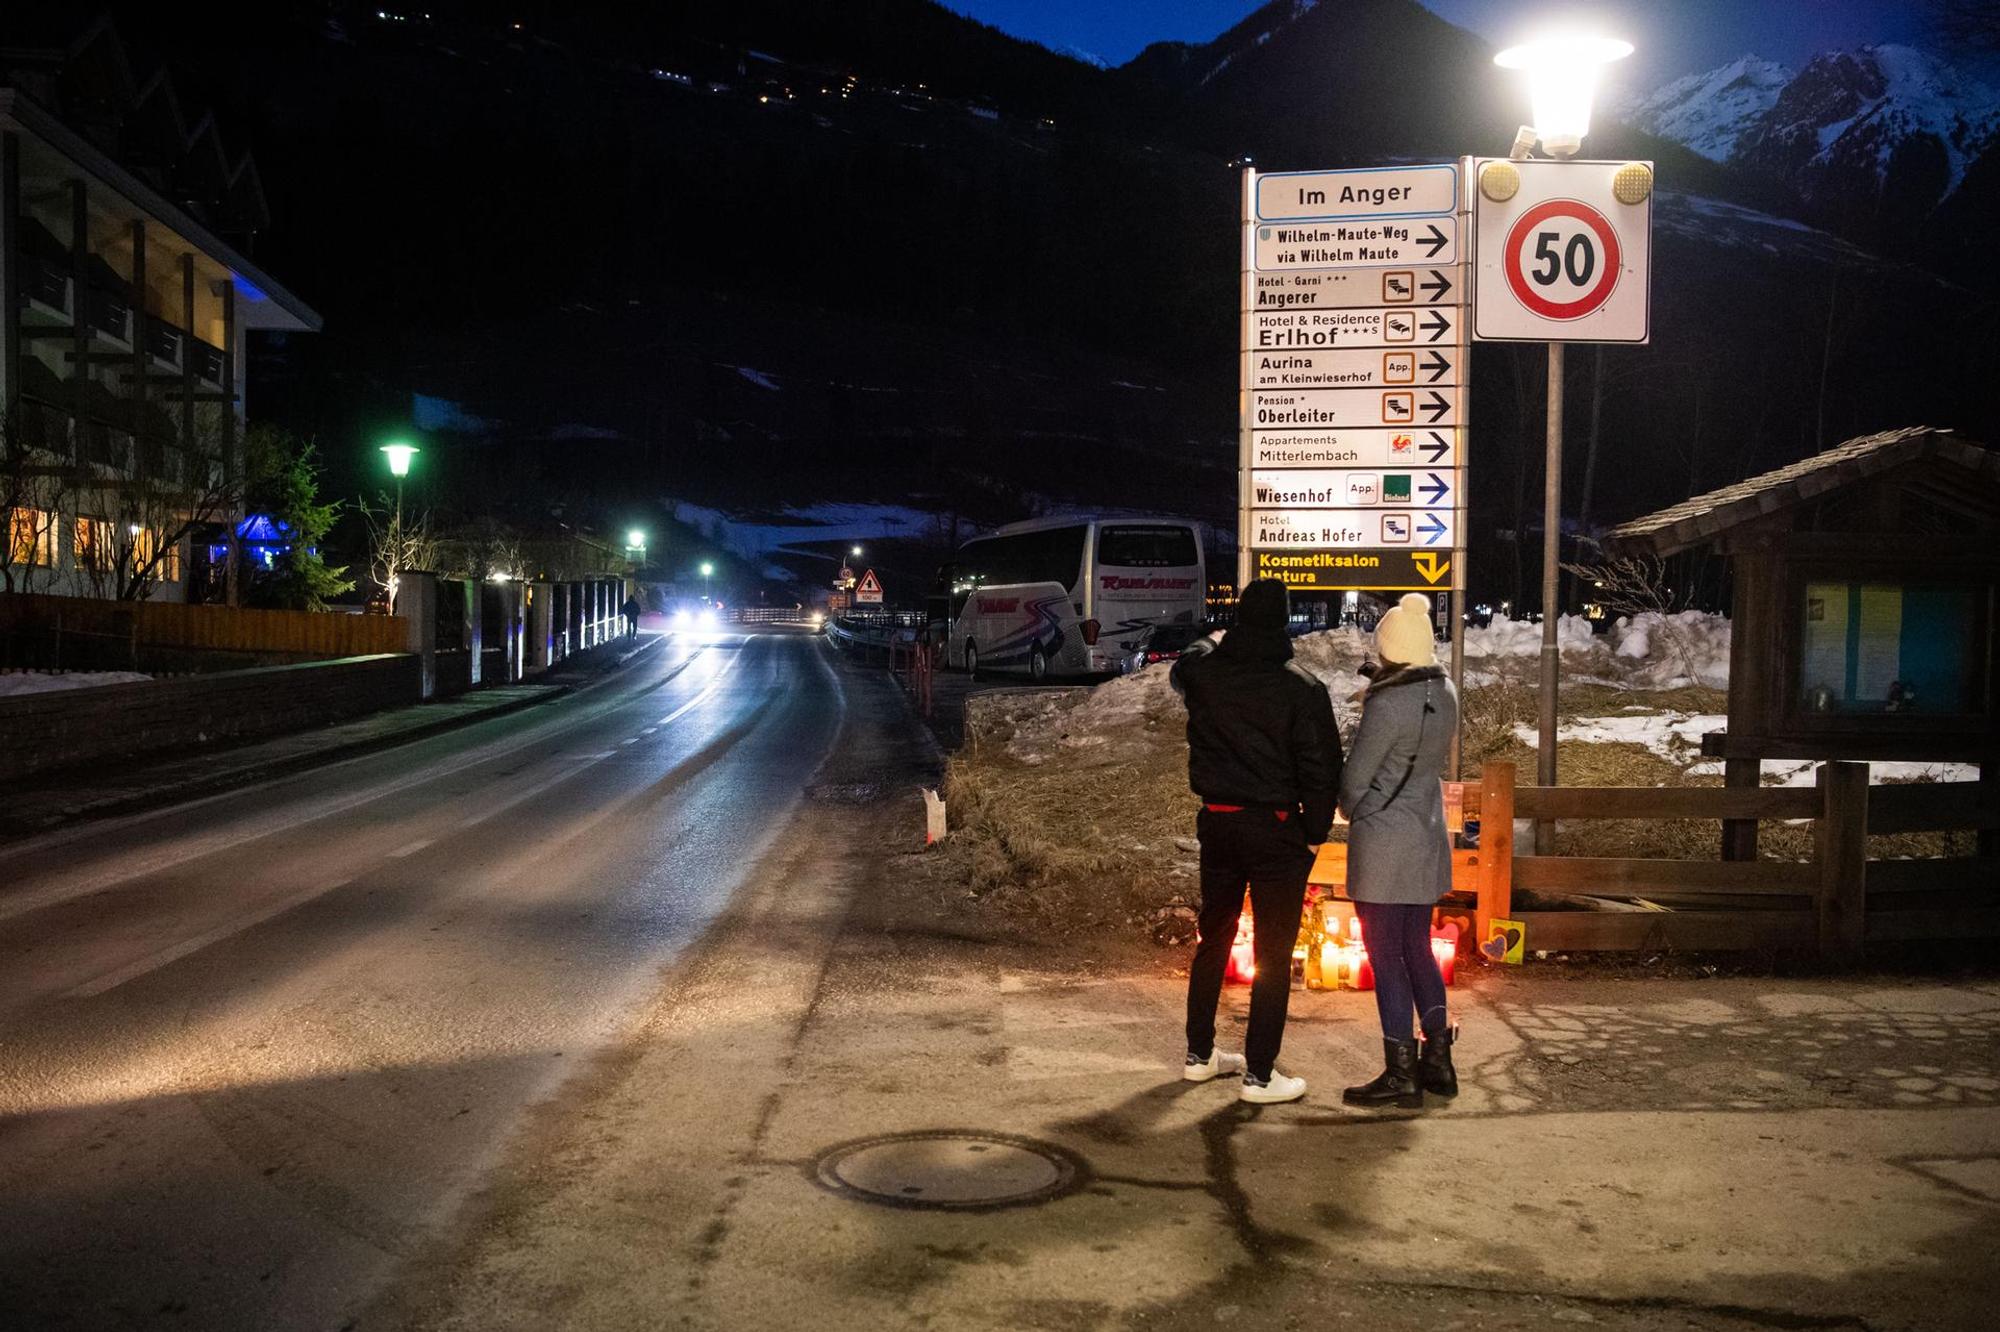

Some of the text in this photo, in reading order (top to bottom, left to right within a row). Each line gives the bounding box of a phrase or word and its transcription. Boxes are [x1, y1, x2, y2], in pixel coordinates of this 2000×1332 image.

[1300, 186, 1411, 205] Im Anger
[1278, 228, 1408, 244] Wilhelm-Maute-Weg
[1277, 247, 1398, 263] via Wilhelm Maute
[1532, 232, 1595, 287] 50
[1258, 277, 1284, 286] Hotel
[1295, 276, 1321, 285] Garni
[1258, 290, 1317, 307] Angerer
[1260, 314, 1380, 326] Hotel & Residence
[1260, 328, 1338, 346] Erlhof
[1261, 356, 1312, 369] Aurina
[1389, 363, 1410, 372] App.
[1282, 372, 1371, 383] Kleinwieserhof
[1258, 396, 1294, 405] Pension
[1258, 409, 1335, 423] Oberleiter
[1261, 436, 1336, 446] Appartements
[1260, 450, 1357, 461] Mitterlembach
[1256, 488, 1332, 502] Wiesenhof
[1351, 484, 1374, 493] App.
[1260, 516, 1289, 525] Hotel
[1259, 529, 1362, 542] Andreas Hofer
[1259, 554, 1380, 567] Kosmetiksalon
